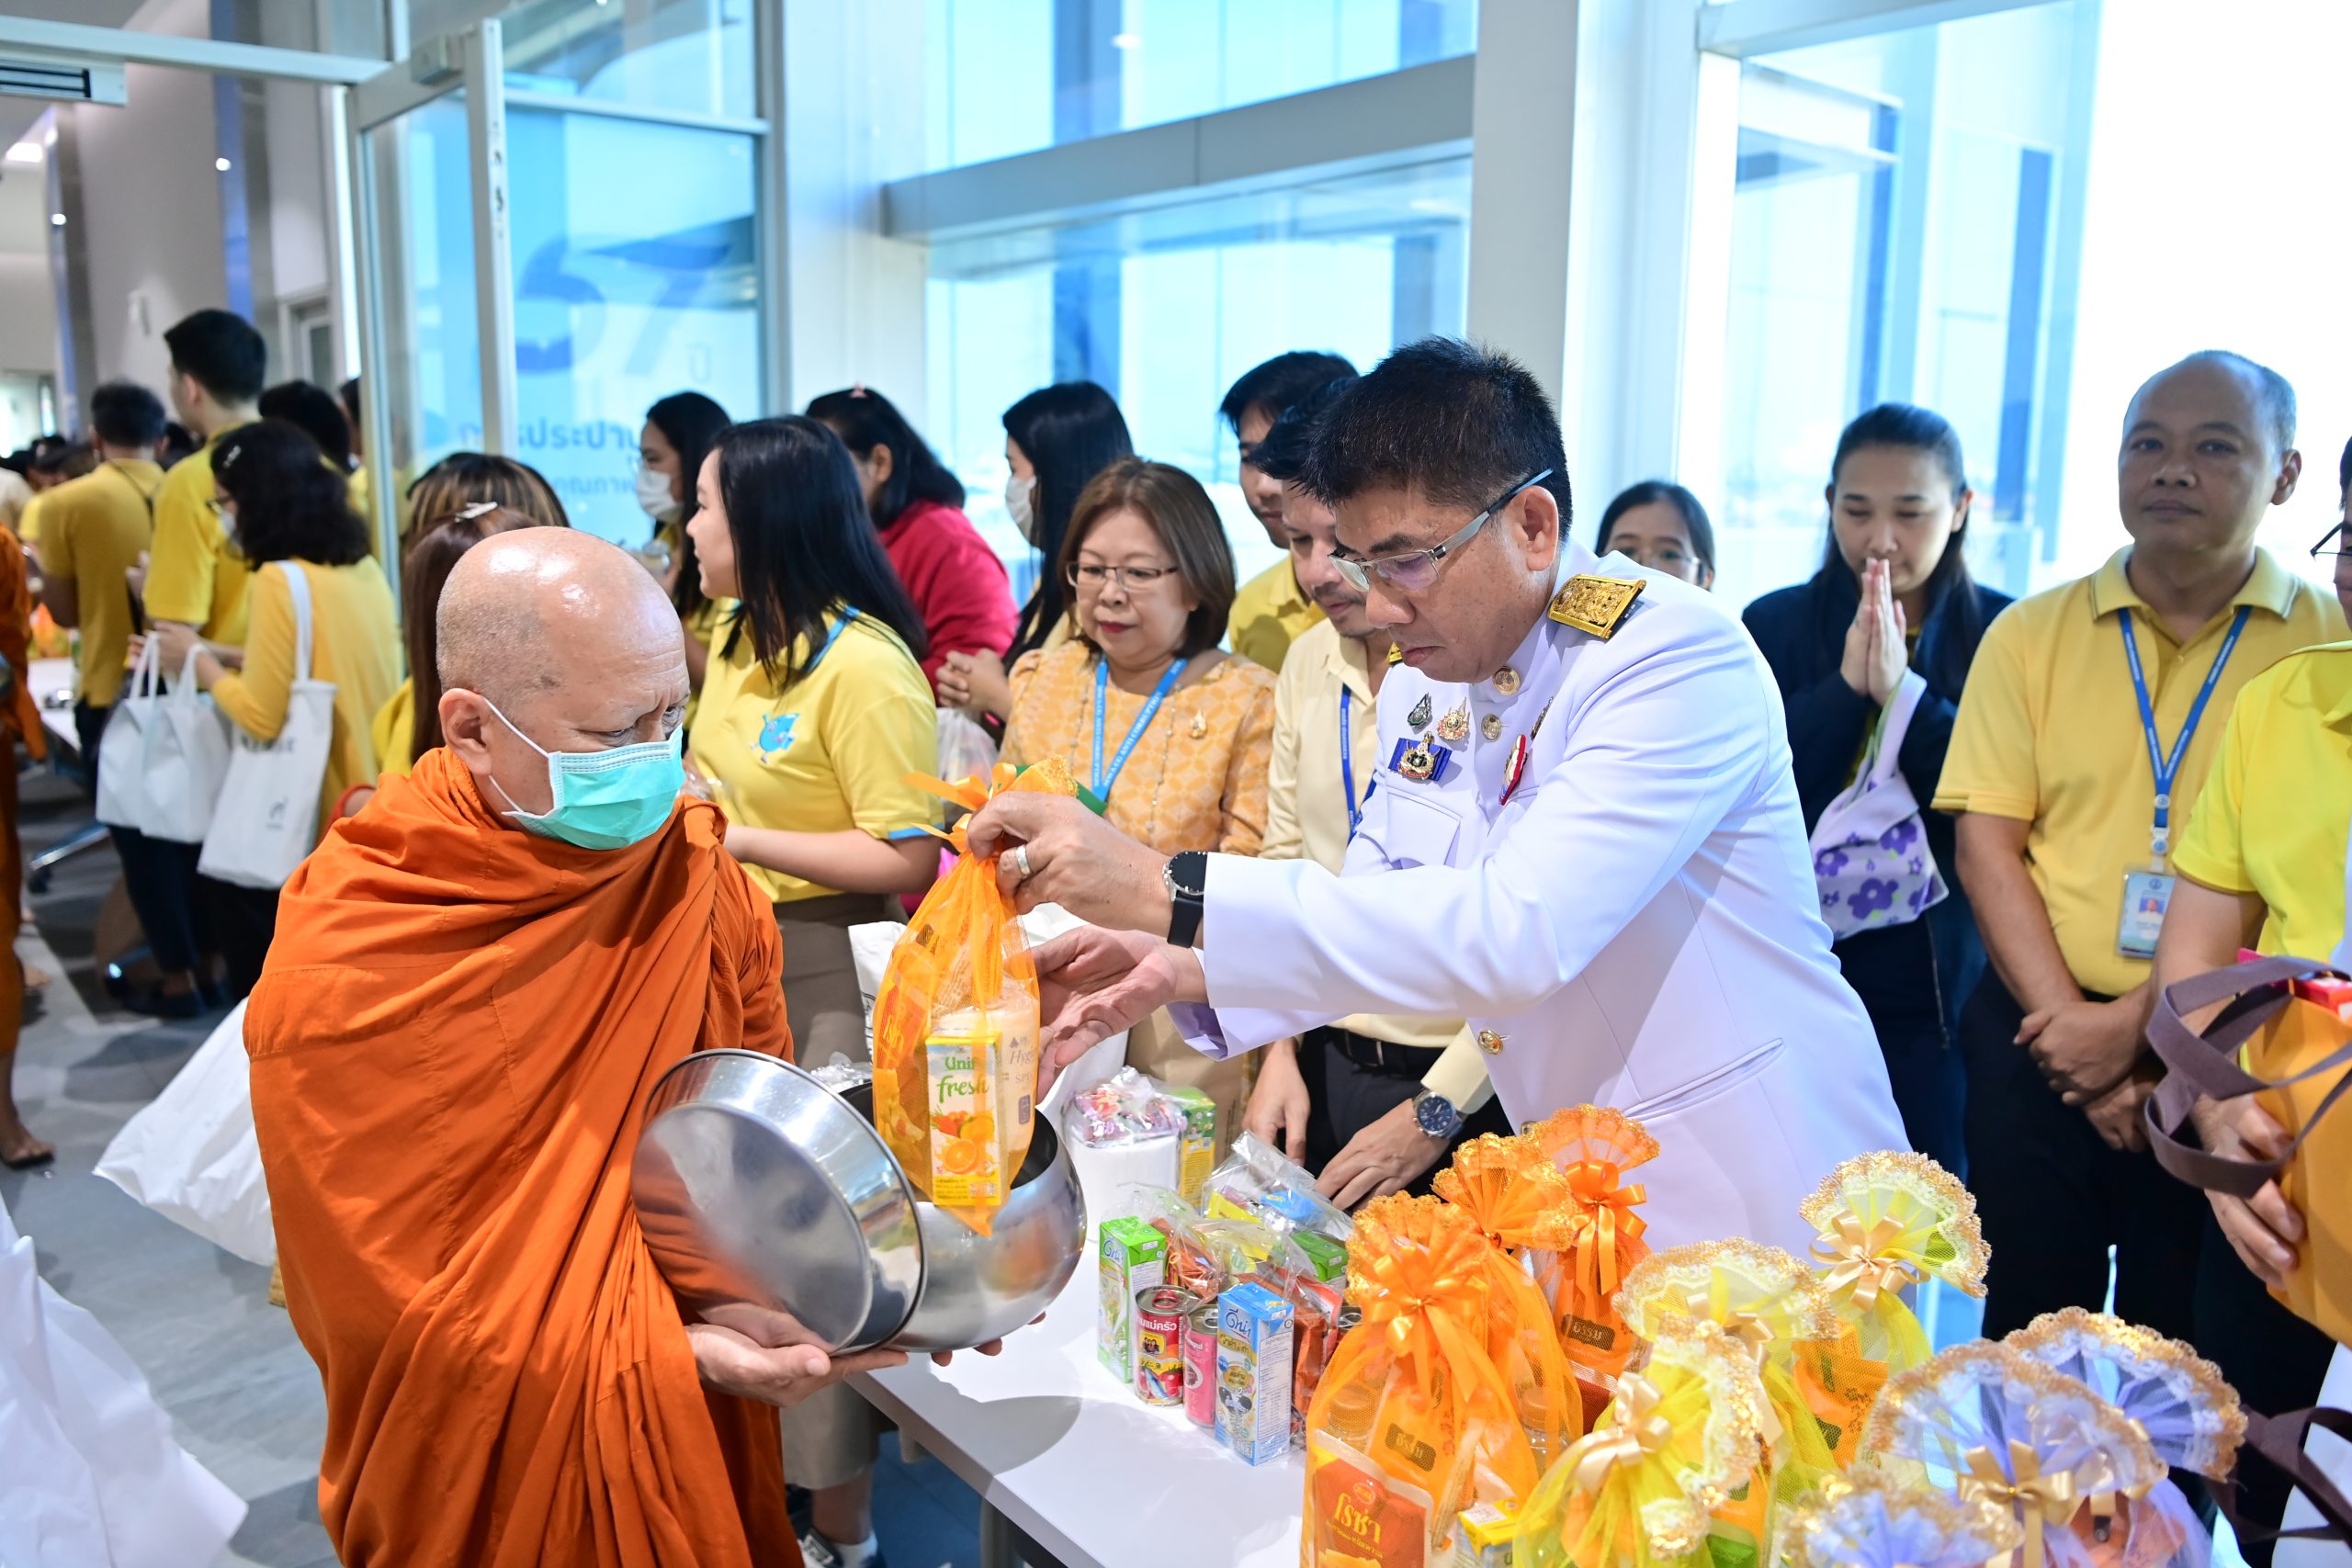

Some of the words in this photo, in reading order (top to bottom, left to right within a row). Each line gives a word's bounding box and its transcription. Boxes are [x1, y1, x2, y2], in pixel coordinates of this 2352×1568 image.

[1120, 738, 1134, 756] ANTI
[1131, 691, 1162, 739] CORRUPTION
[936, 1074, 990, 1103] fresh
